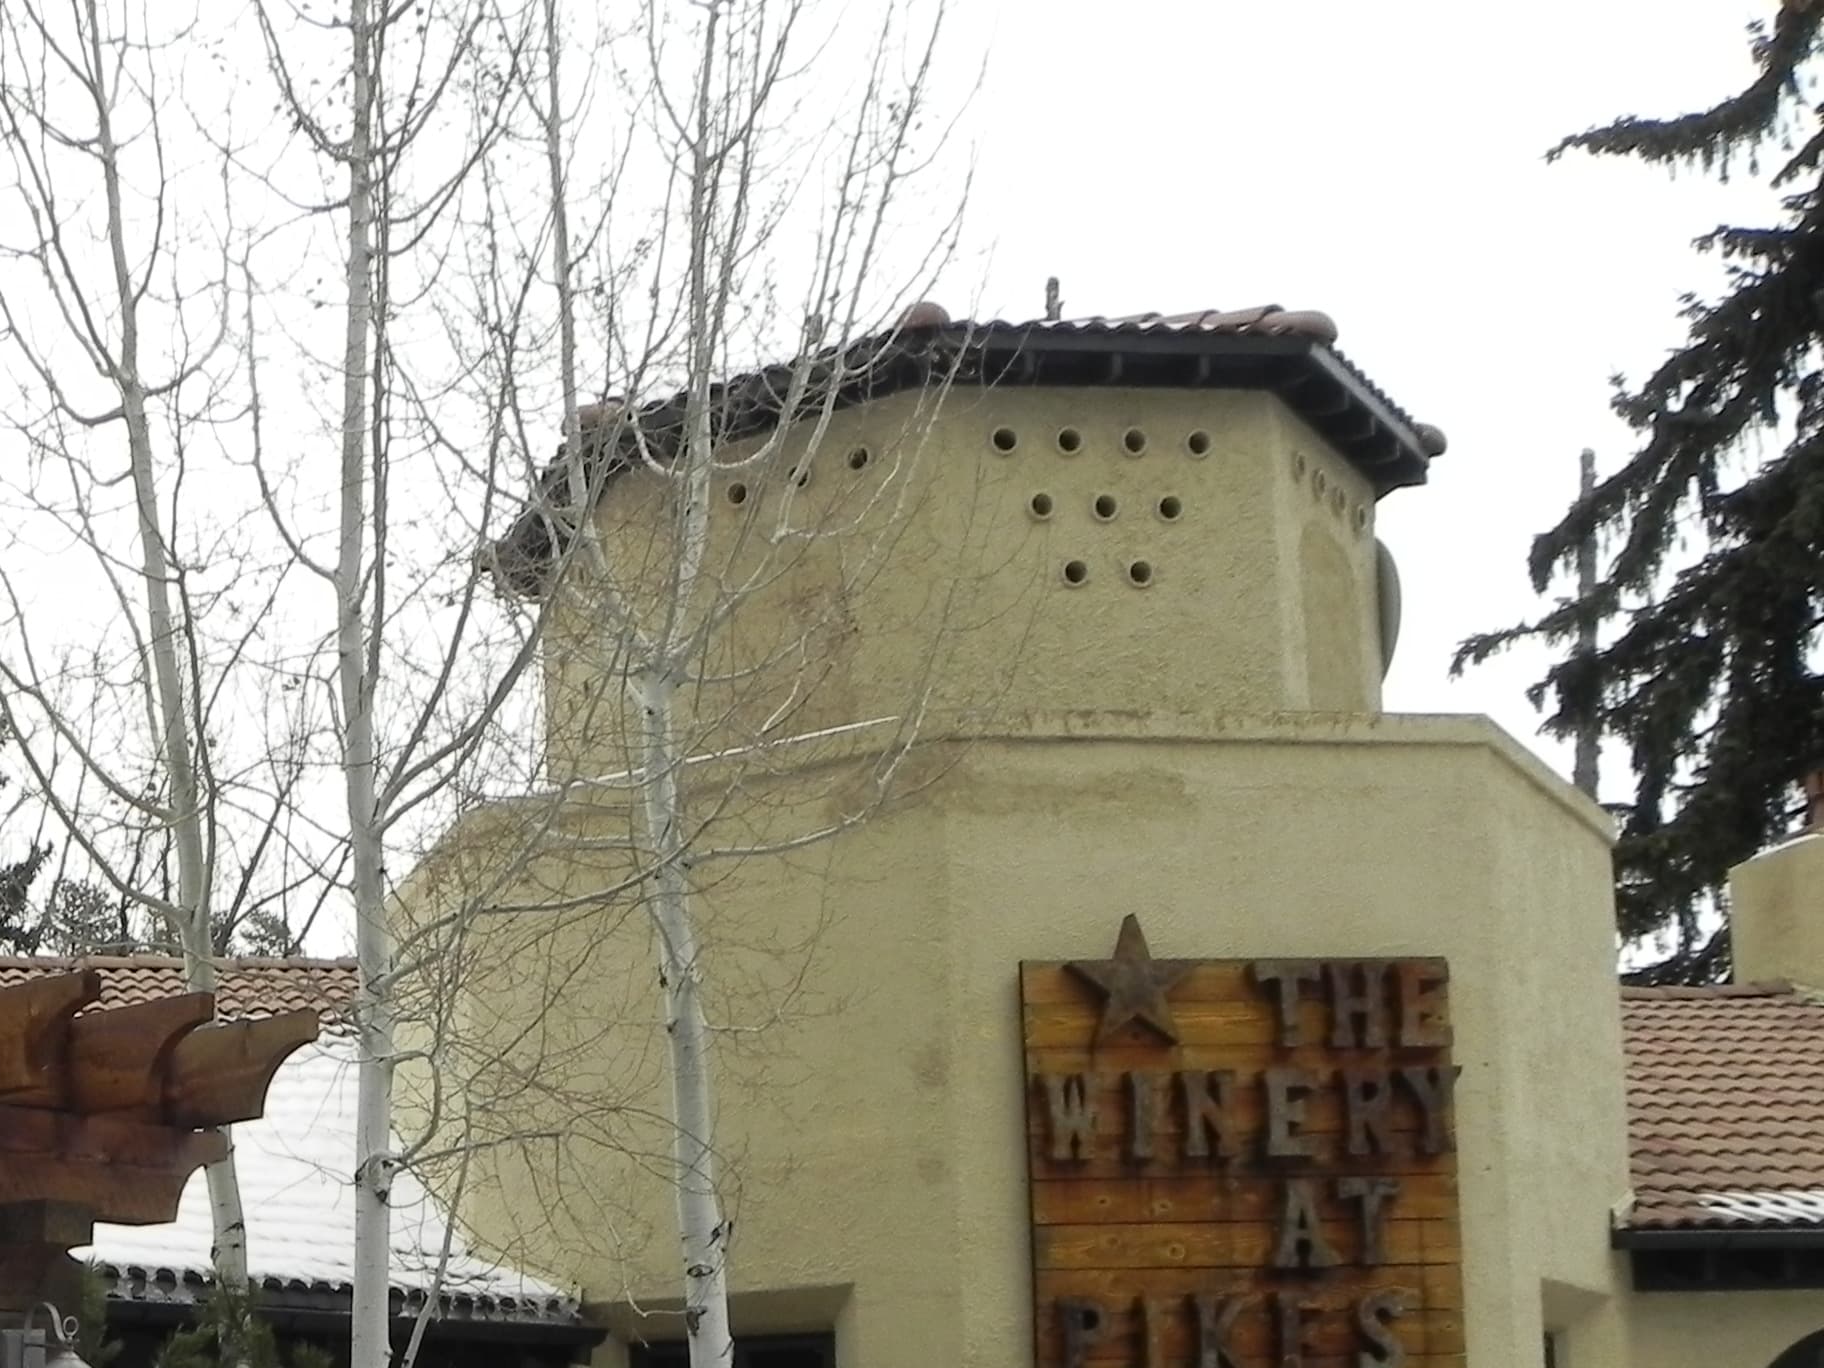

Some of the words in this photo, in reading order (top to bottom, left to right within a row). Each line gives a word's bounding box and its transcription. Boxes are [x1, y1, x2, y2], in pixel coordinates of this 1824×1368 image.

[1251, 960, 1452, 1049] THE
[1036, 1065, 1462, 1160] WINERY
[1277, 1177, 1400, 1267] AT
